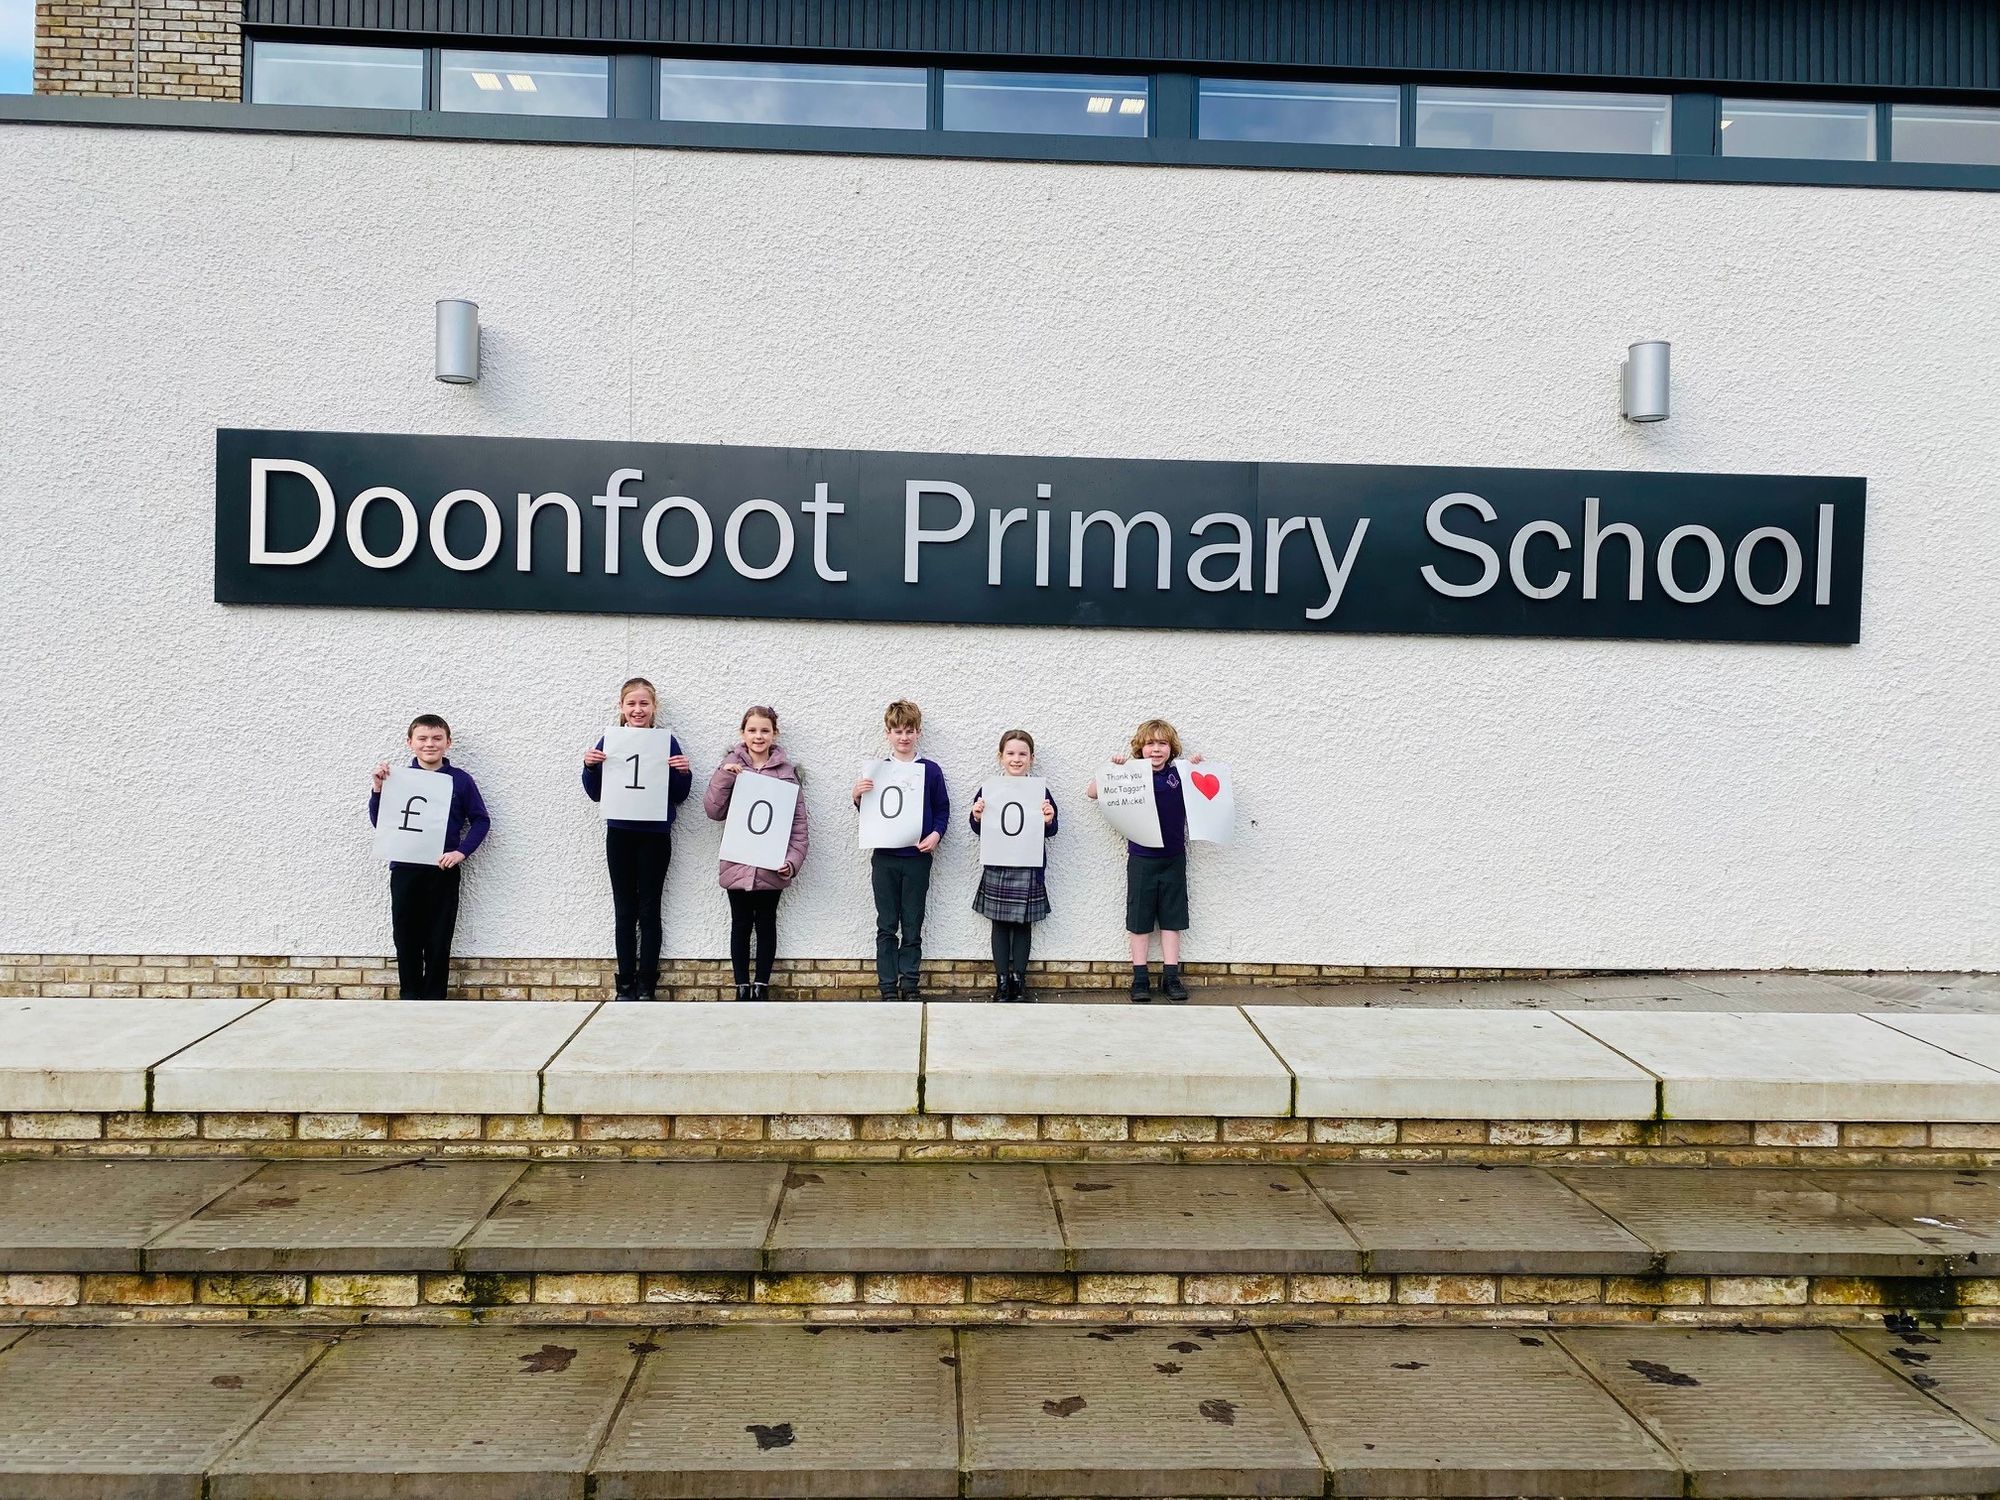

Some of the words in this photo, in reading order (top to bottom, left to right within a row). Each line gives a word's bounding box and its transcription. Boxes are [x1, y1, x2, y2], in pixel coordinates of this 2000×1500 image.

[247, 457, 848, 583] Doonfoot
[903, 479, 1372, 620] Primary
[1419, 492, 1836, 607] School
[624, 753, 646, 790] 1
[1106, 773, 1129, 781] Thank
[1130, 772, 1143, 782] you
[398, 795, 428, 833] £
[880, 785, 903, 819] 0
[1107, 799, 1120, 807] and
[747, 804, 774, 836] 0
[1000, 804, 1025, 837] 0
